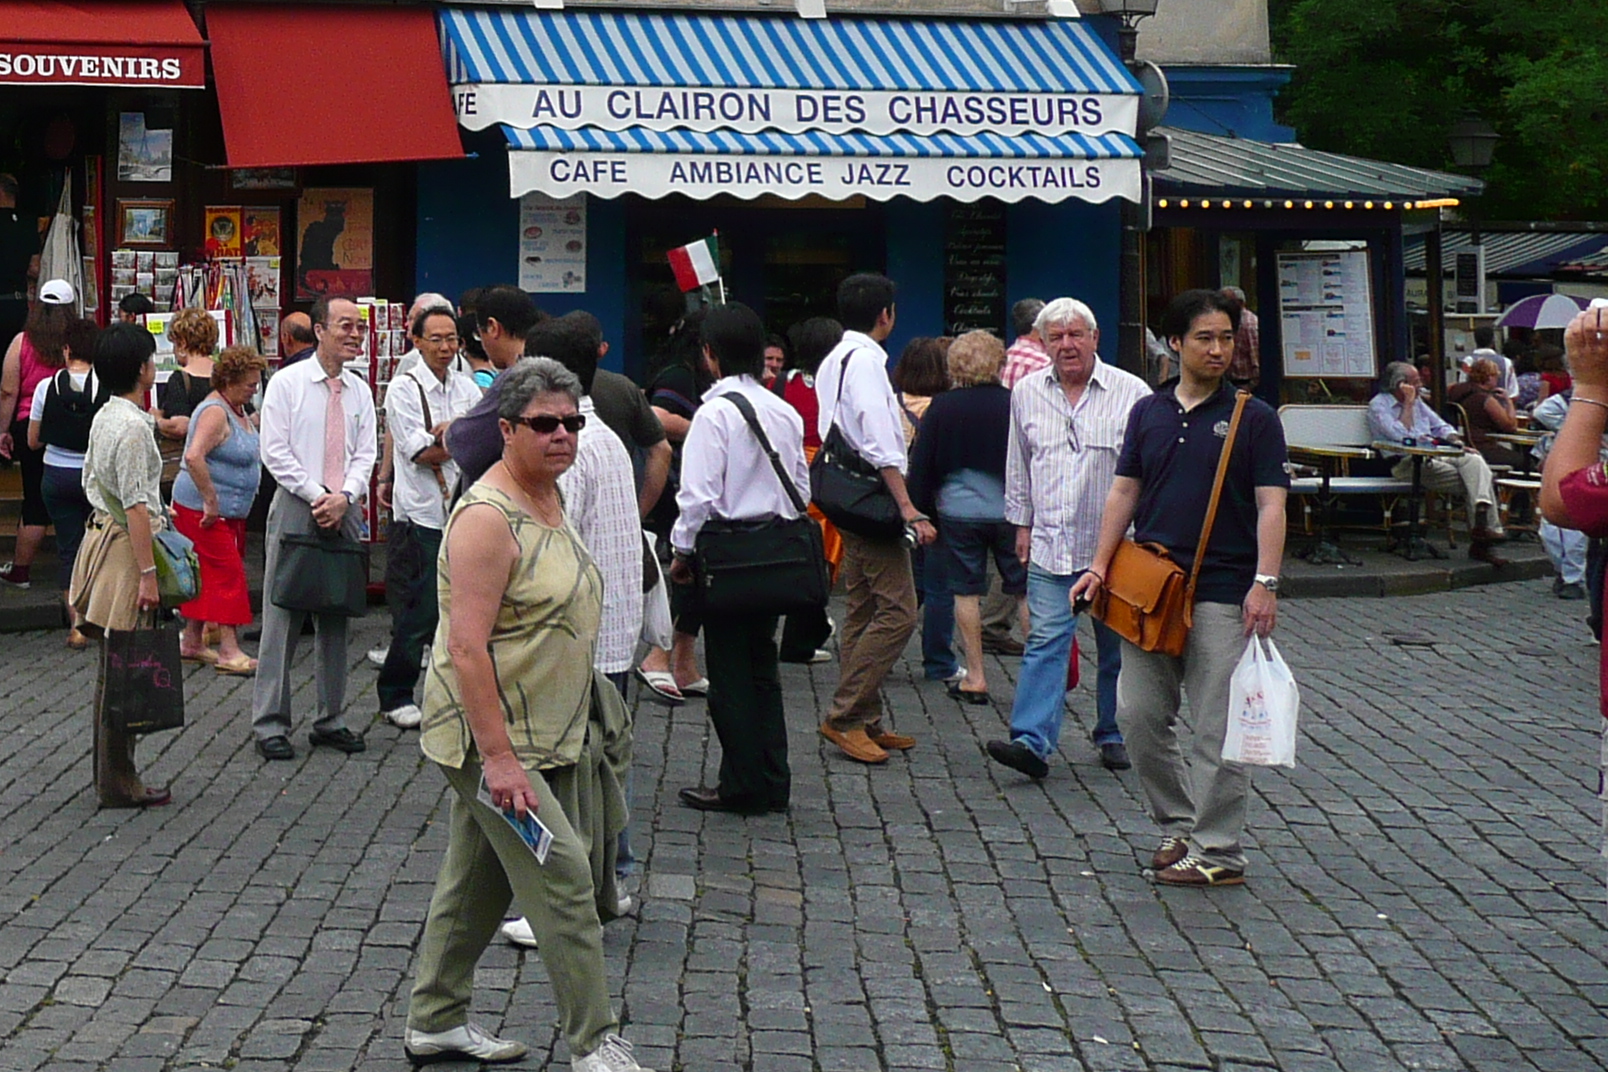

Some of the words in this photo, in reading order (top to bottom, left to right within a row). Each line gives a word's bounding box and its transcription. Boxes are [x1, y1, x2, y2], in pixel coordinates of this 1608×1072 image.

[531, 89, 583, 119] AU
[606, 90, 772, 122] CLAIRON
[795, 92, 866, 124] DES
[888, 94, 1104, 126] CHASSEURS
[549, 158, 628, 184] CAFE
[669, 160, 824, 186] AMBIANCE
[840, 162, 911, 187] JAZZ
[946, 164, 1102, 189] COCKTAILS
